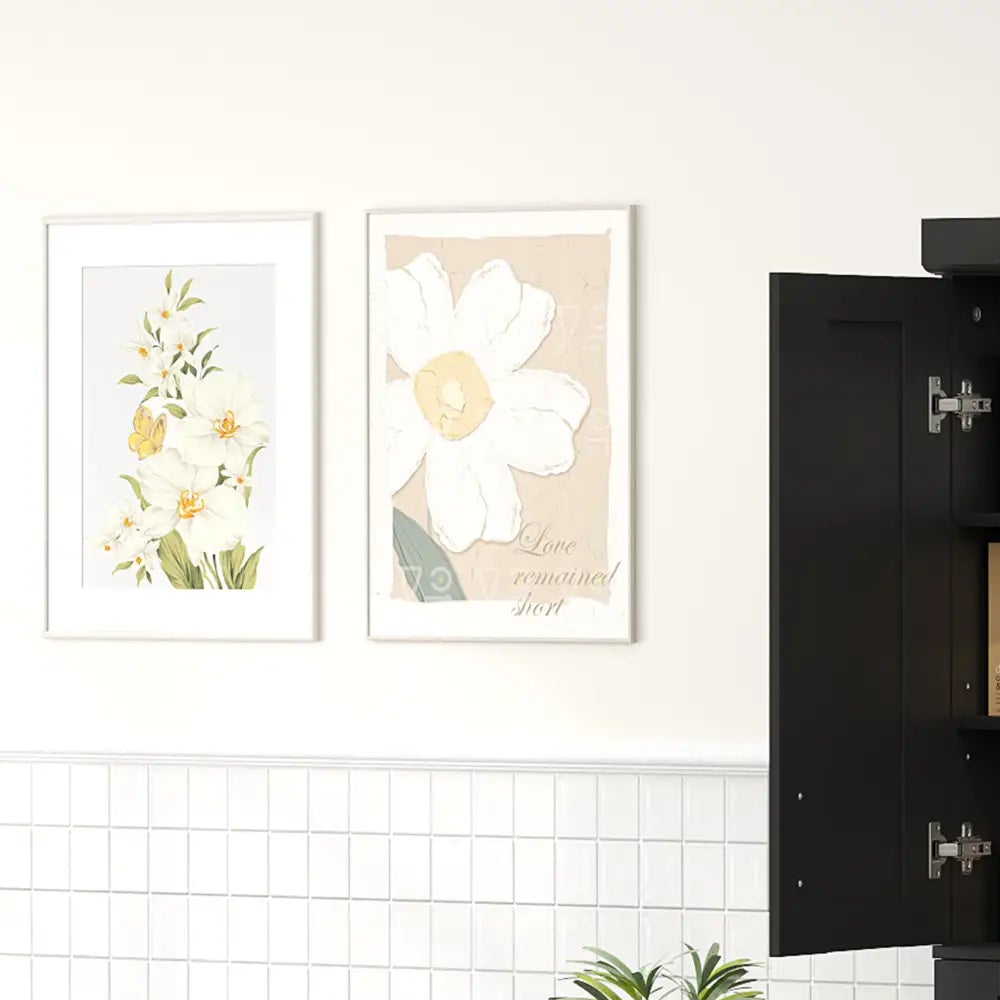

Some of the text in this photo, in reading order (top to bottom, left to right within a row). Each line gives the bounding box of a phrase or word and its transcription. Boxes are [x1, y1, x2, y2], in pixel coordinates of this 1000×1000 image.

[515, 521, 576, 557] Love
[513, 561, 621, 586] remained
[511, 591, 564, 617] short
